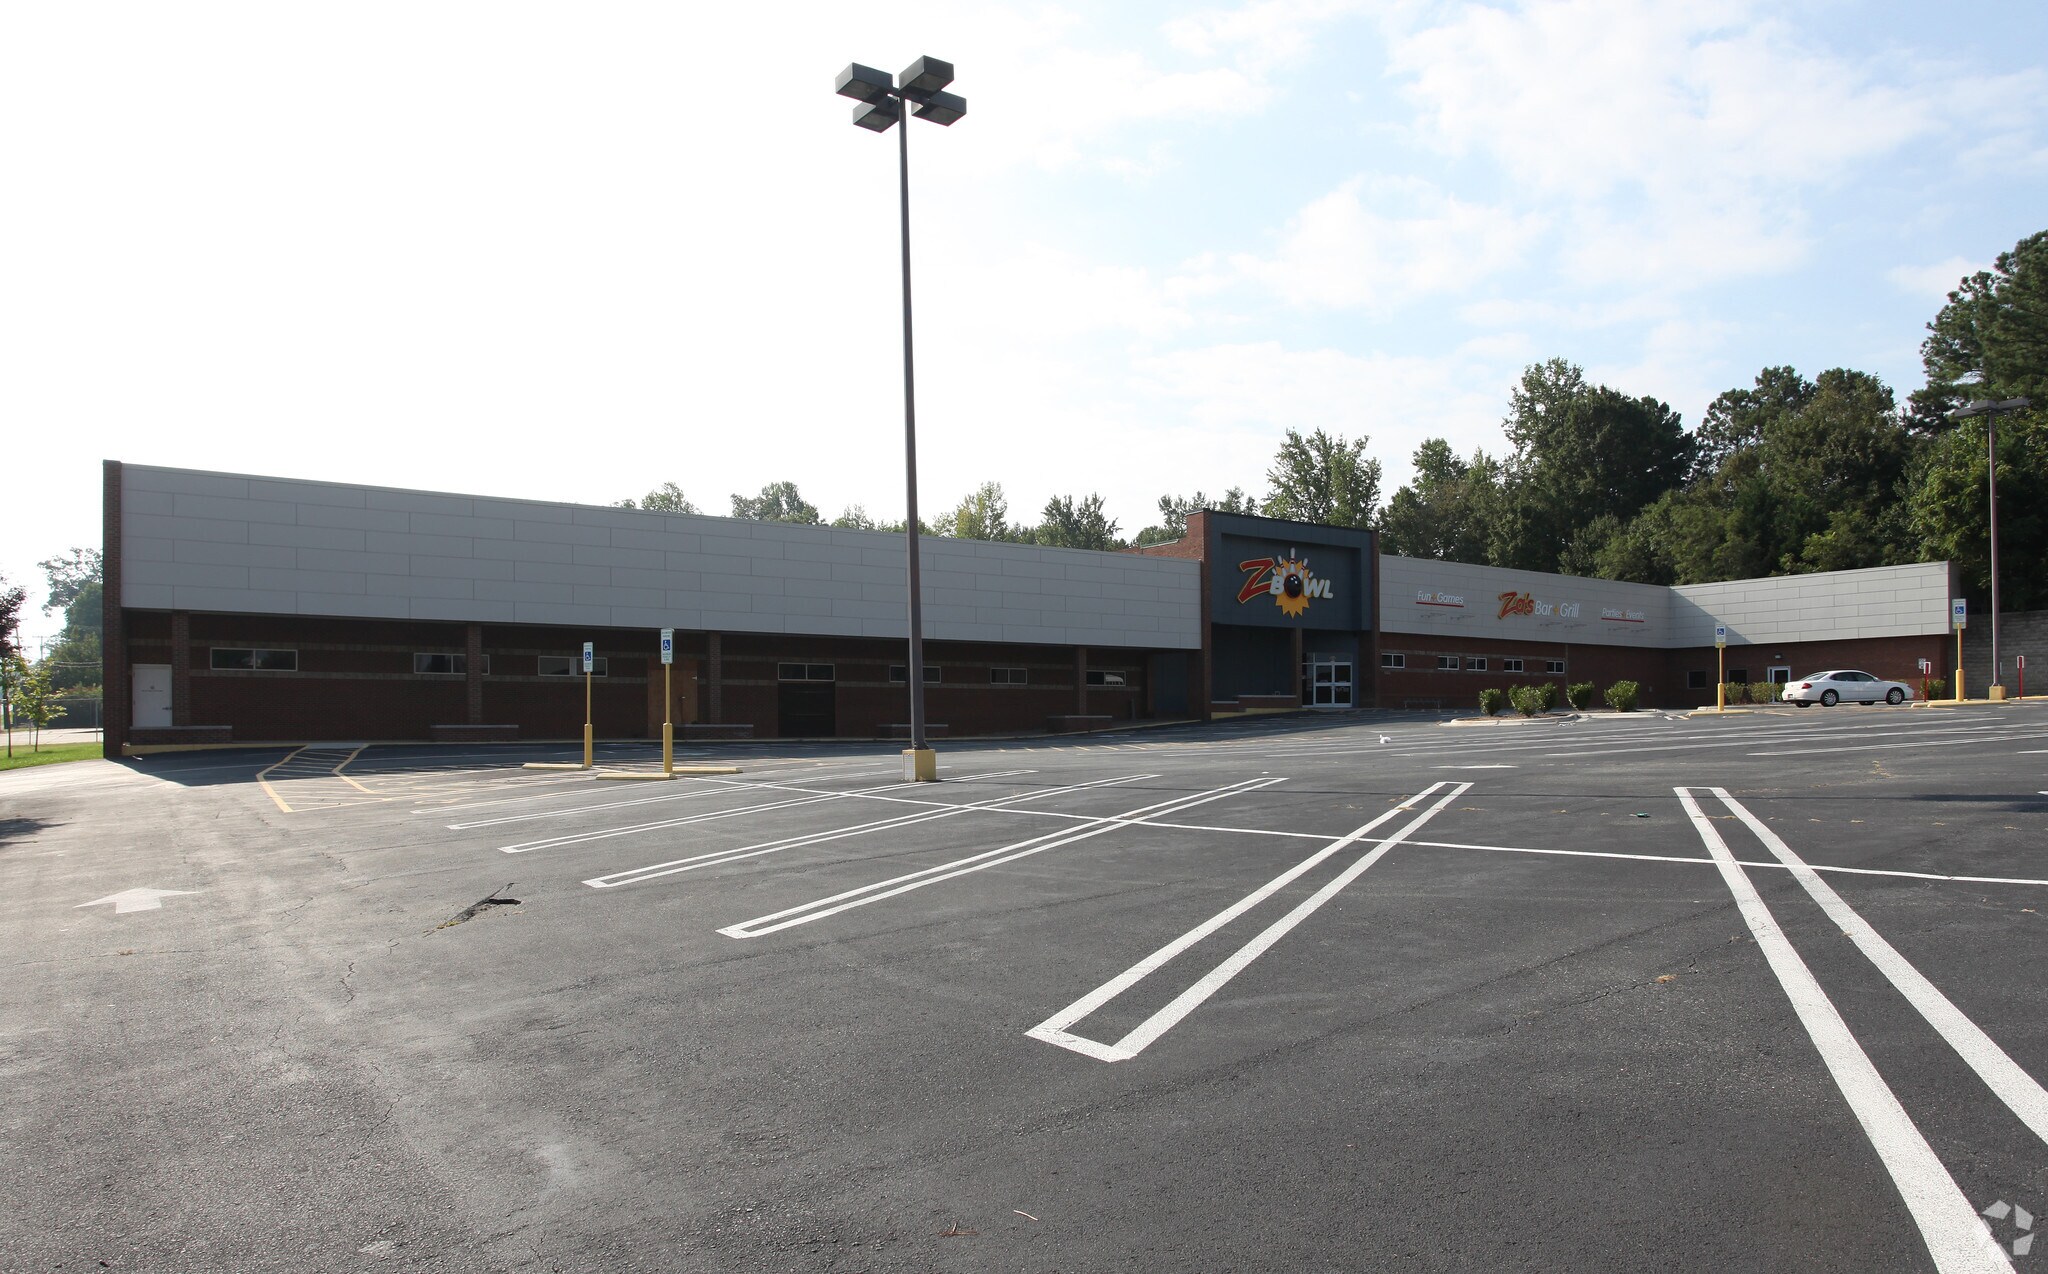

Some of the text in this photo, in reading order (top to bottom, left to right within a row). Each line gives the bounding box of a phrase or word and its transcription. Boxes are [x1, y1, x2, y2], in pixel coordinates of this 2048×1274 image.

[1437, 592, 1464, 604] Games
[1535, 600, 1552, 616] Bar
[1560, 602, 1580, 618] Grill
